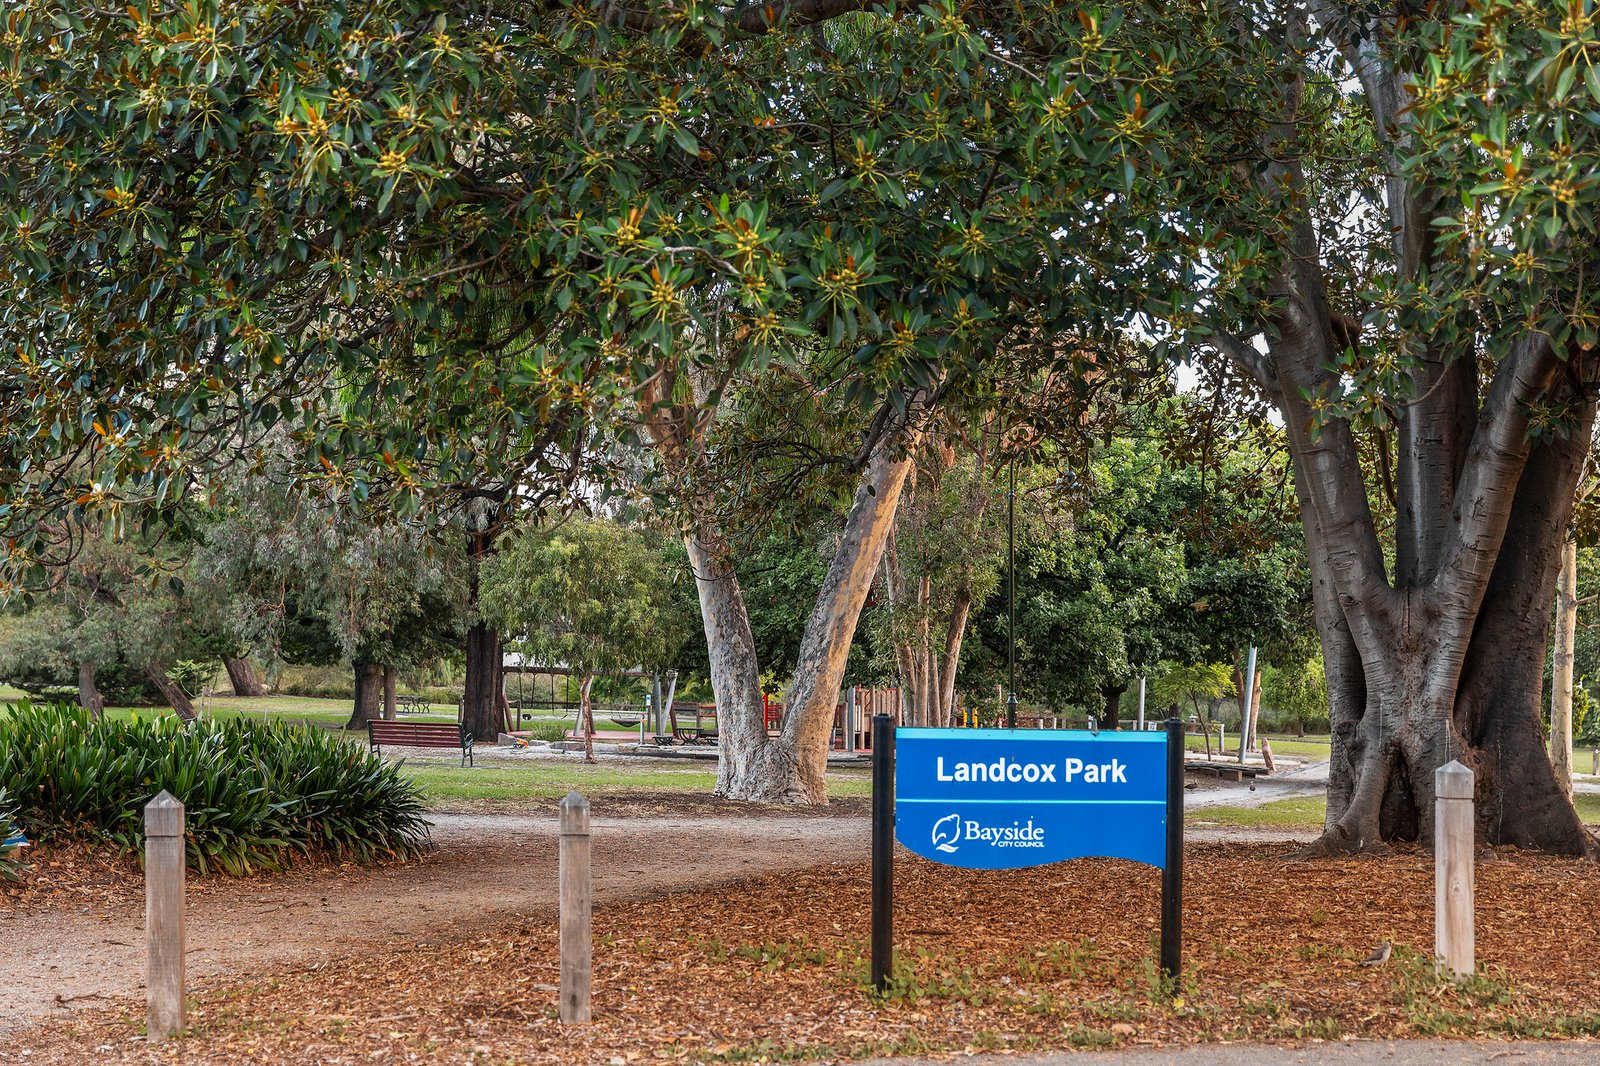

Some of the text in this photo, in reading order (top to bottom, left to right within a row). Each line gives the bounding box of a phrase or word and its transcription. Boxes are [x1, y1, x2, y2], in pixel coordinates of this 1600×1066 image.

[937, 757, 1127, 783] Landcox Park
[964, 820, 1045, 847] Bayside
[997, 840, 1013, 848] CITY
